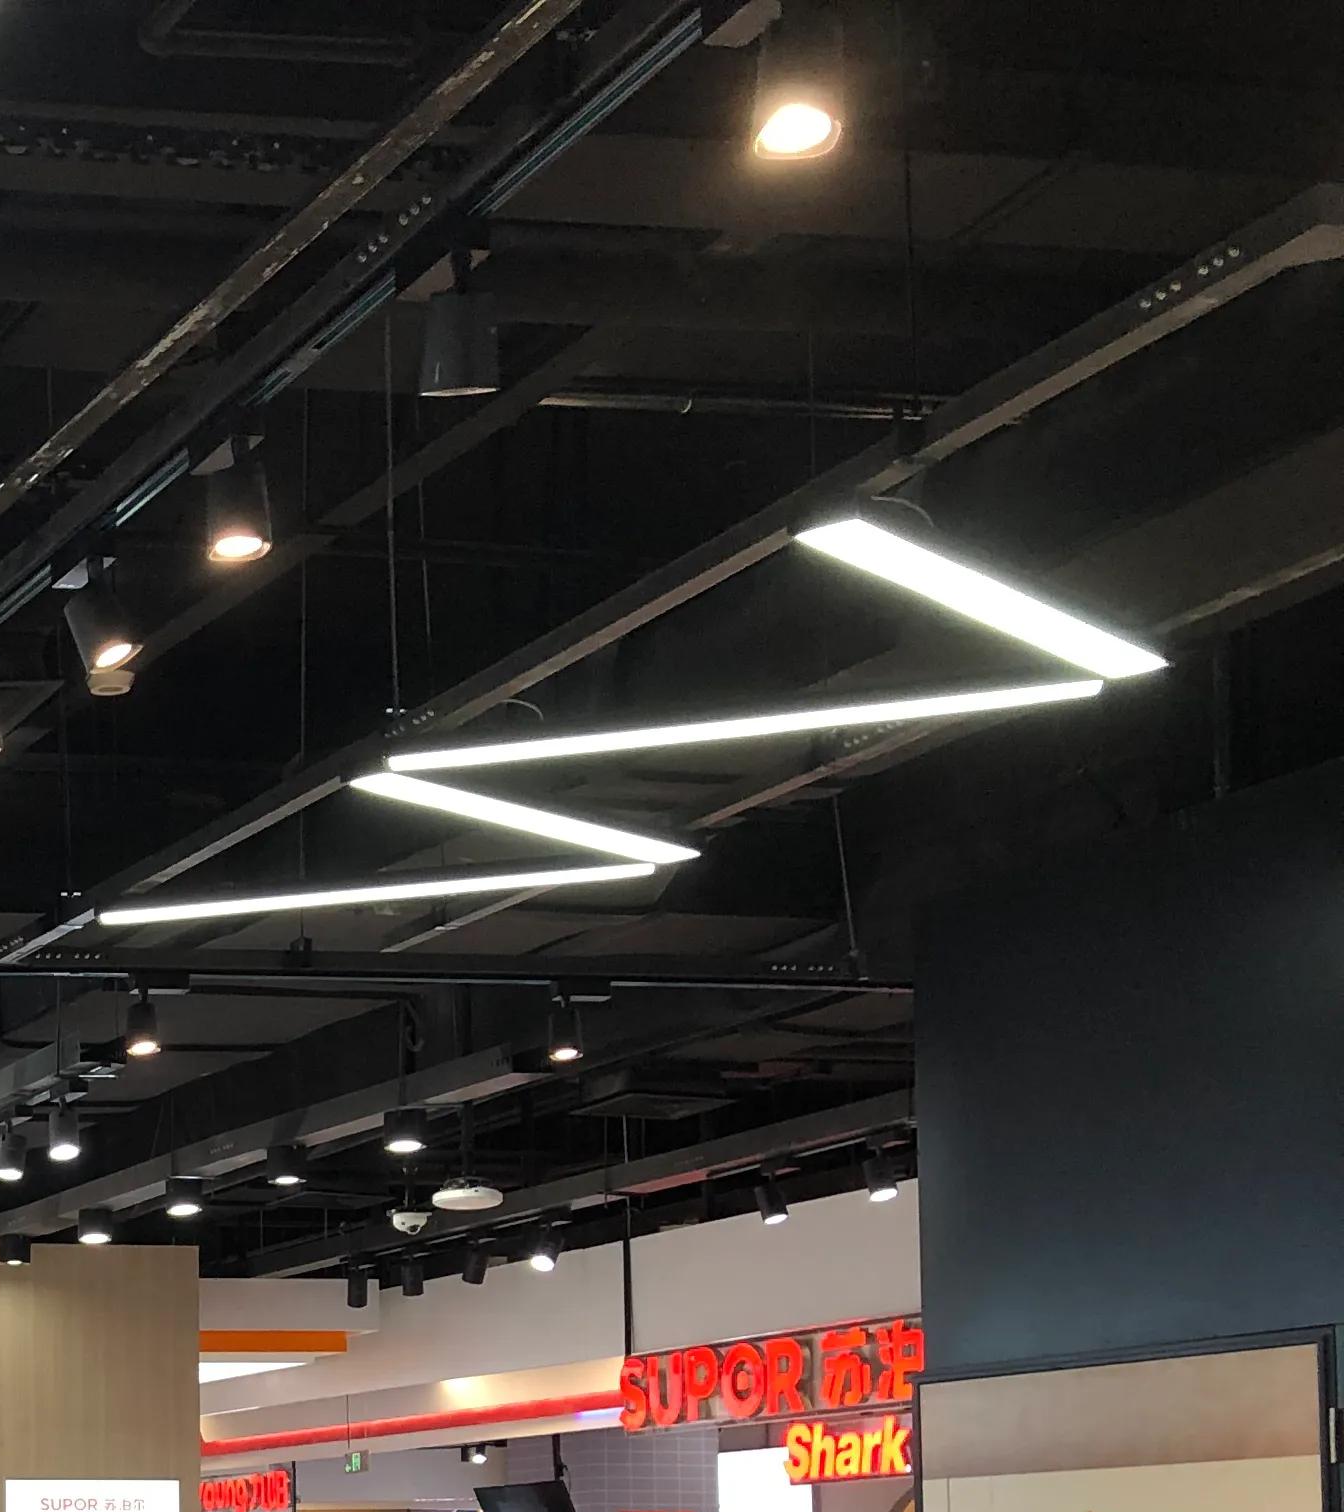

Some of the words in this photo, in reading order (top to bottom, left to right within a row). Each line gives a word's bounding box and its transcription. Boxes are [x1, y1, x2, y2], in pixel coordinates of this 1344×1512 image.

[620, 1338, 806, 1432] SUPOR
[784, 1414, 912, 1486] Shark
[40, 1497, 98, 1511] SUPOR
